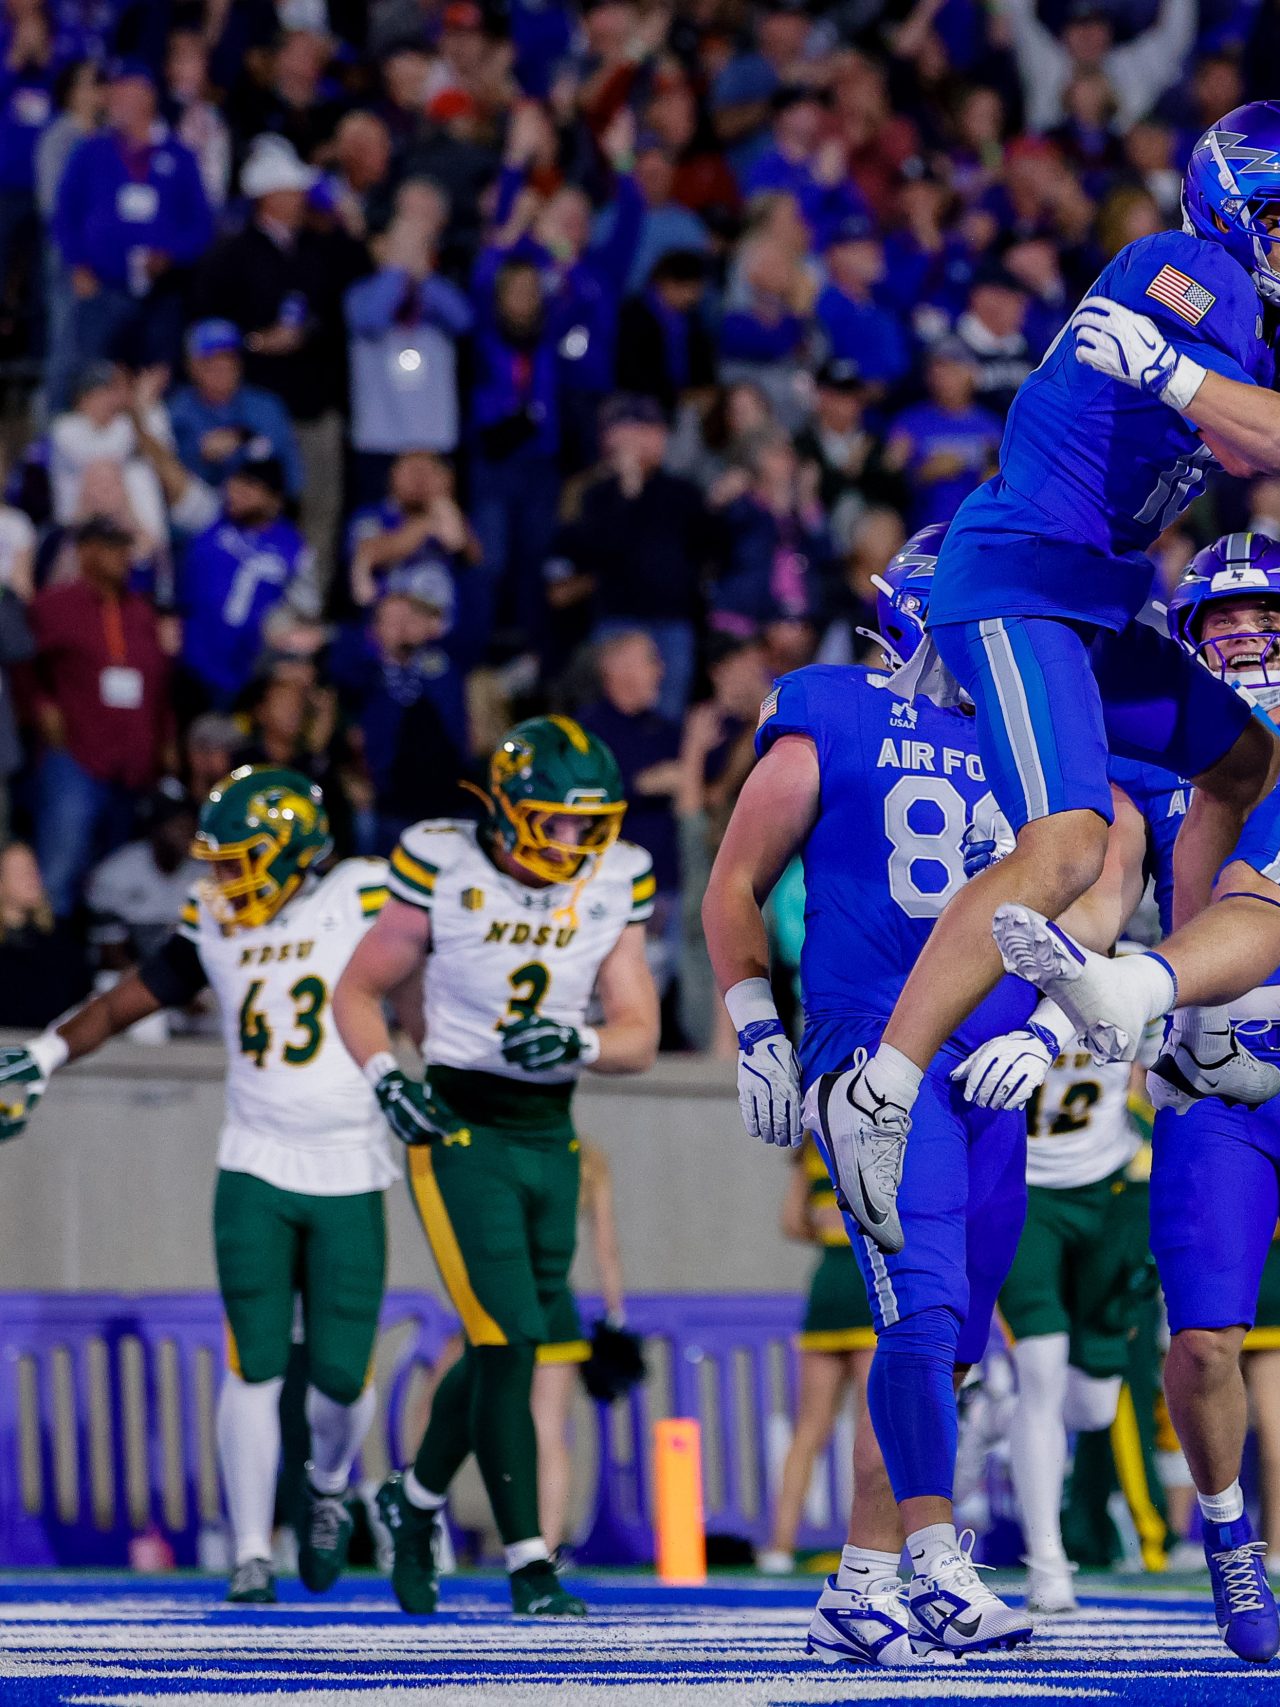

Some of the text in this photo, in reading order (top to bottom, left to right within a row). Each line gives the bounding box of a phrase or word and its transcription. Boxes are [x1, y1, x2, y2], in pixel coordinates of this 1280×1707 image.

[889, 717, 916, 731] USAA
[876, 737, 936, 772] AIR
[483, 920, 578, 949] NDSU
[239, 974, 327, 1069] 43
